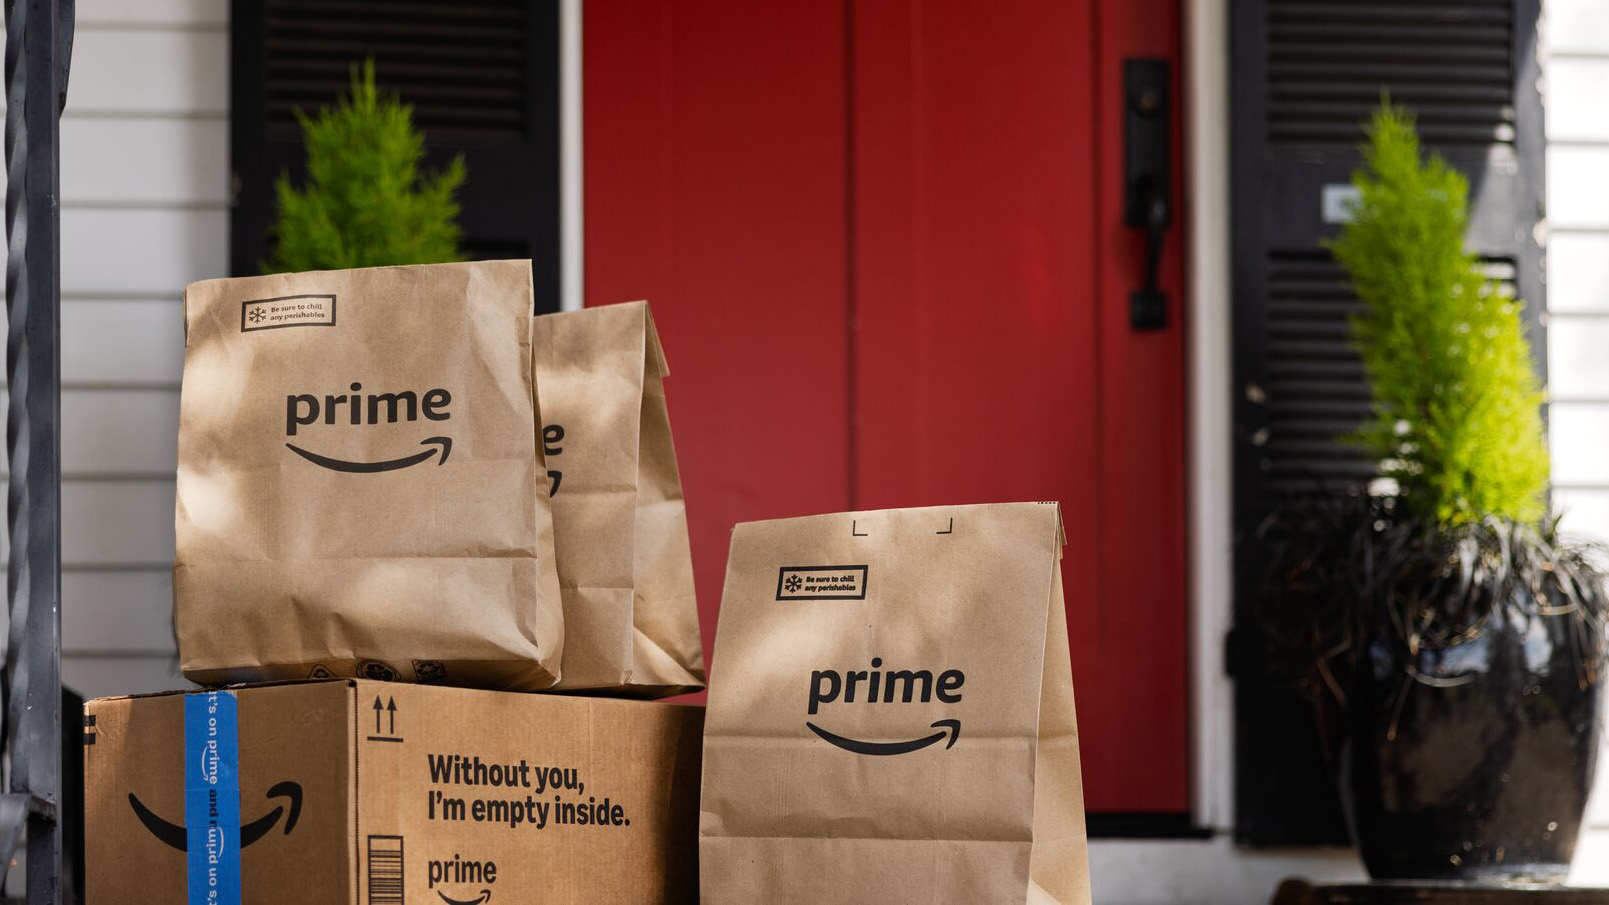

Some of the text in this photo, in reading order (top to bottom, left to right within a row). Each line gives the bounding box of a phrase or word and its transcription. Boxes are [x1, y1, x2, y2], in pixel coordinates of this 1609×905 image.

[284, 311, 325, 320] perishables
[286, 382, 452, 436] prime
[804, 584, 856, 593] any perishables
[808, 657, 965, 715] prime
[209, 717, 217, 736] on
[207, 740, 220, 785] prime
[427, 753, 585, 795] Without you,
[209, 788, 219, 817] and
[428, 790, 631, 829] I'm empty inside.
[206, 828, 219, 864] prim
[208, 867, 217, 887] on
[428, 853, 497, 889] prime
